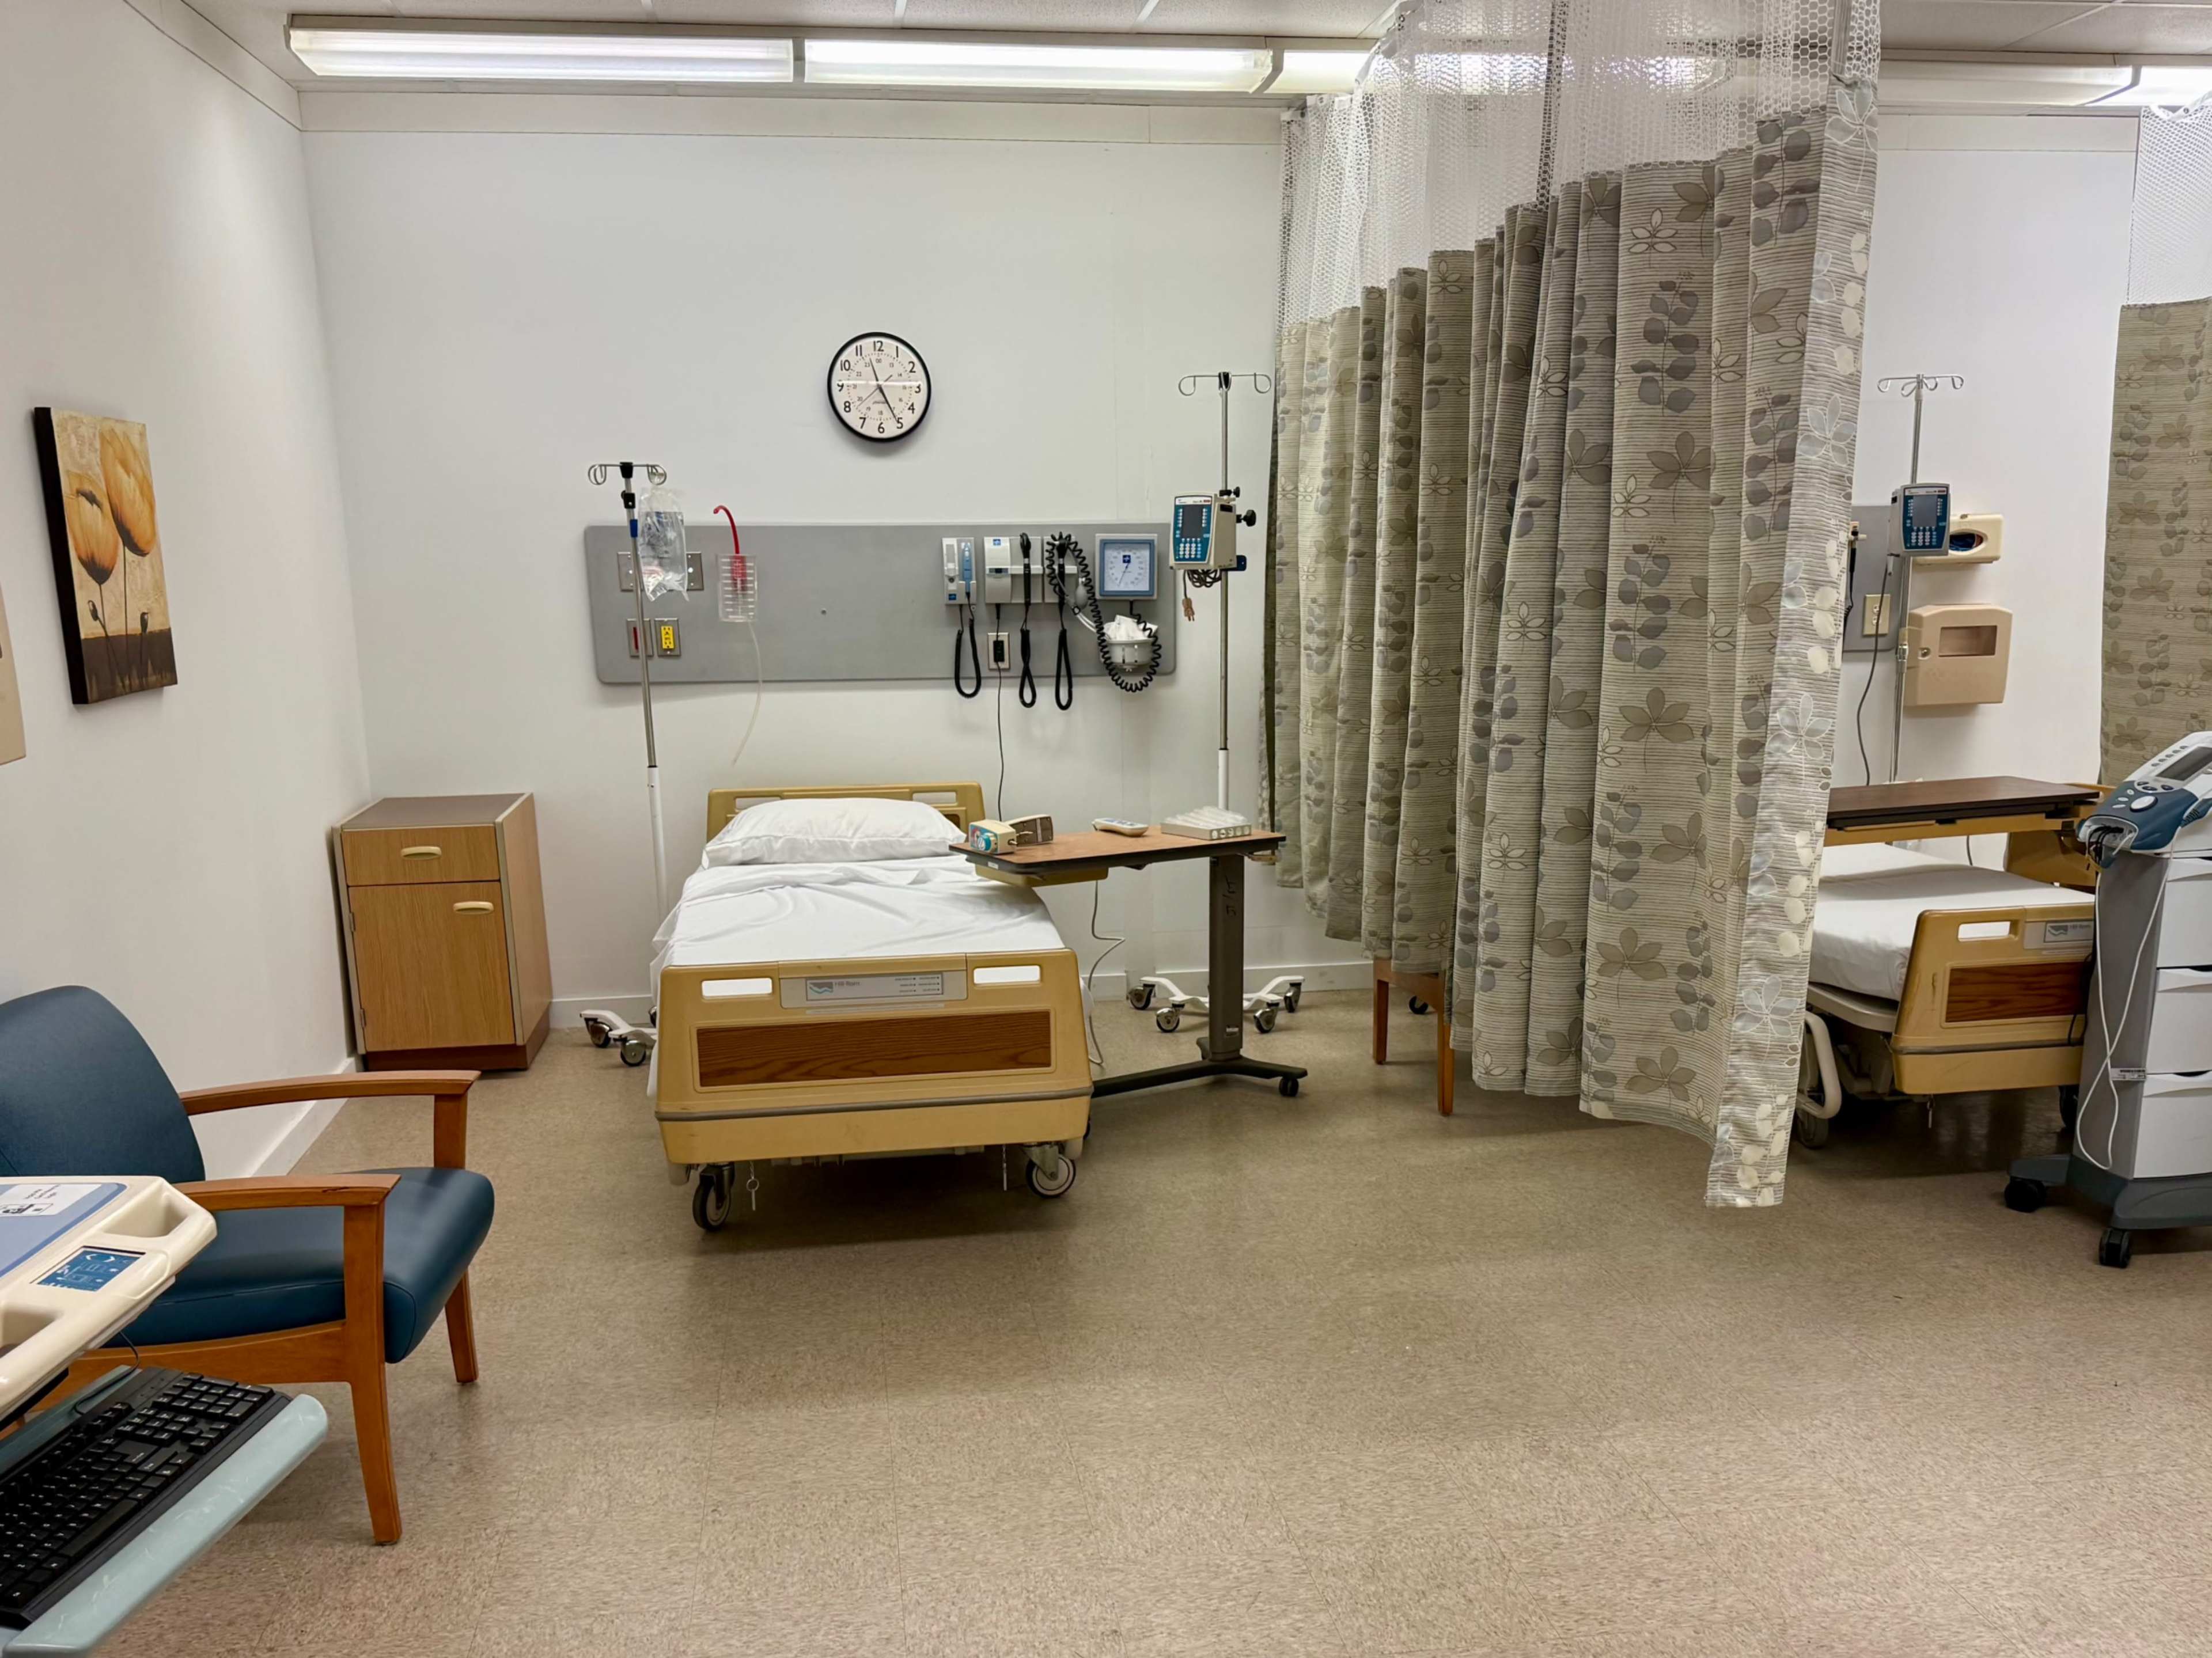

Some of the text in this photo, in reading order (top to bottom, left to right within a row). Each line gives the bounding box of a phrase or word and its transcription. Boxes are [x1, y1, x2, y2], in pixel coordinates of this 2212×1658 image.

[855, 344, 862, 356] 11
[873, 341, 884, 352] 12
[896, 346, 899, 358] 1
[840, 359, 851, 371] 10
[908, 361, 916, 373] 2
[844, 401, 851, 412] 8
[908, 403, 915, 414] 4
[859, 417, 866, 429] 7
[878, 422, 885, 434] 6
[896, 418, 903, 429] 5
